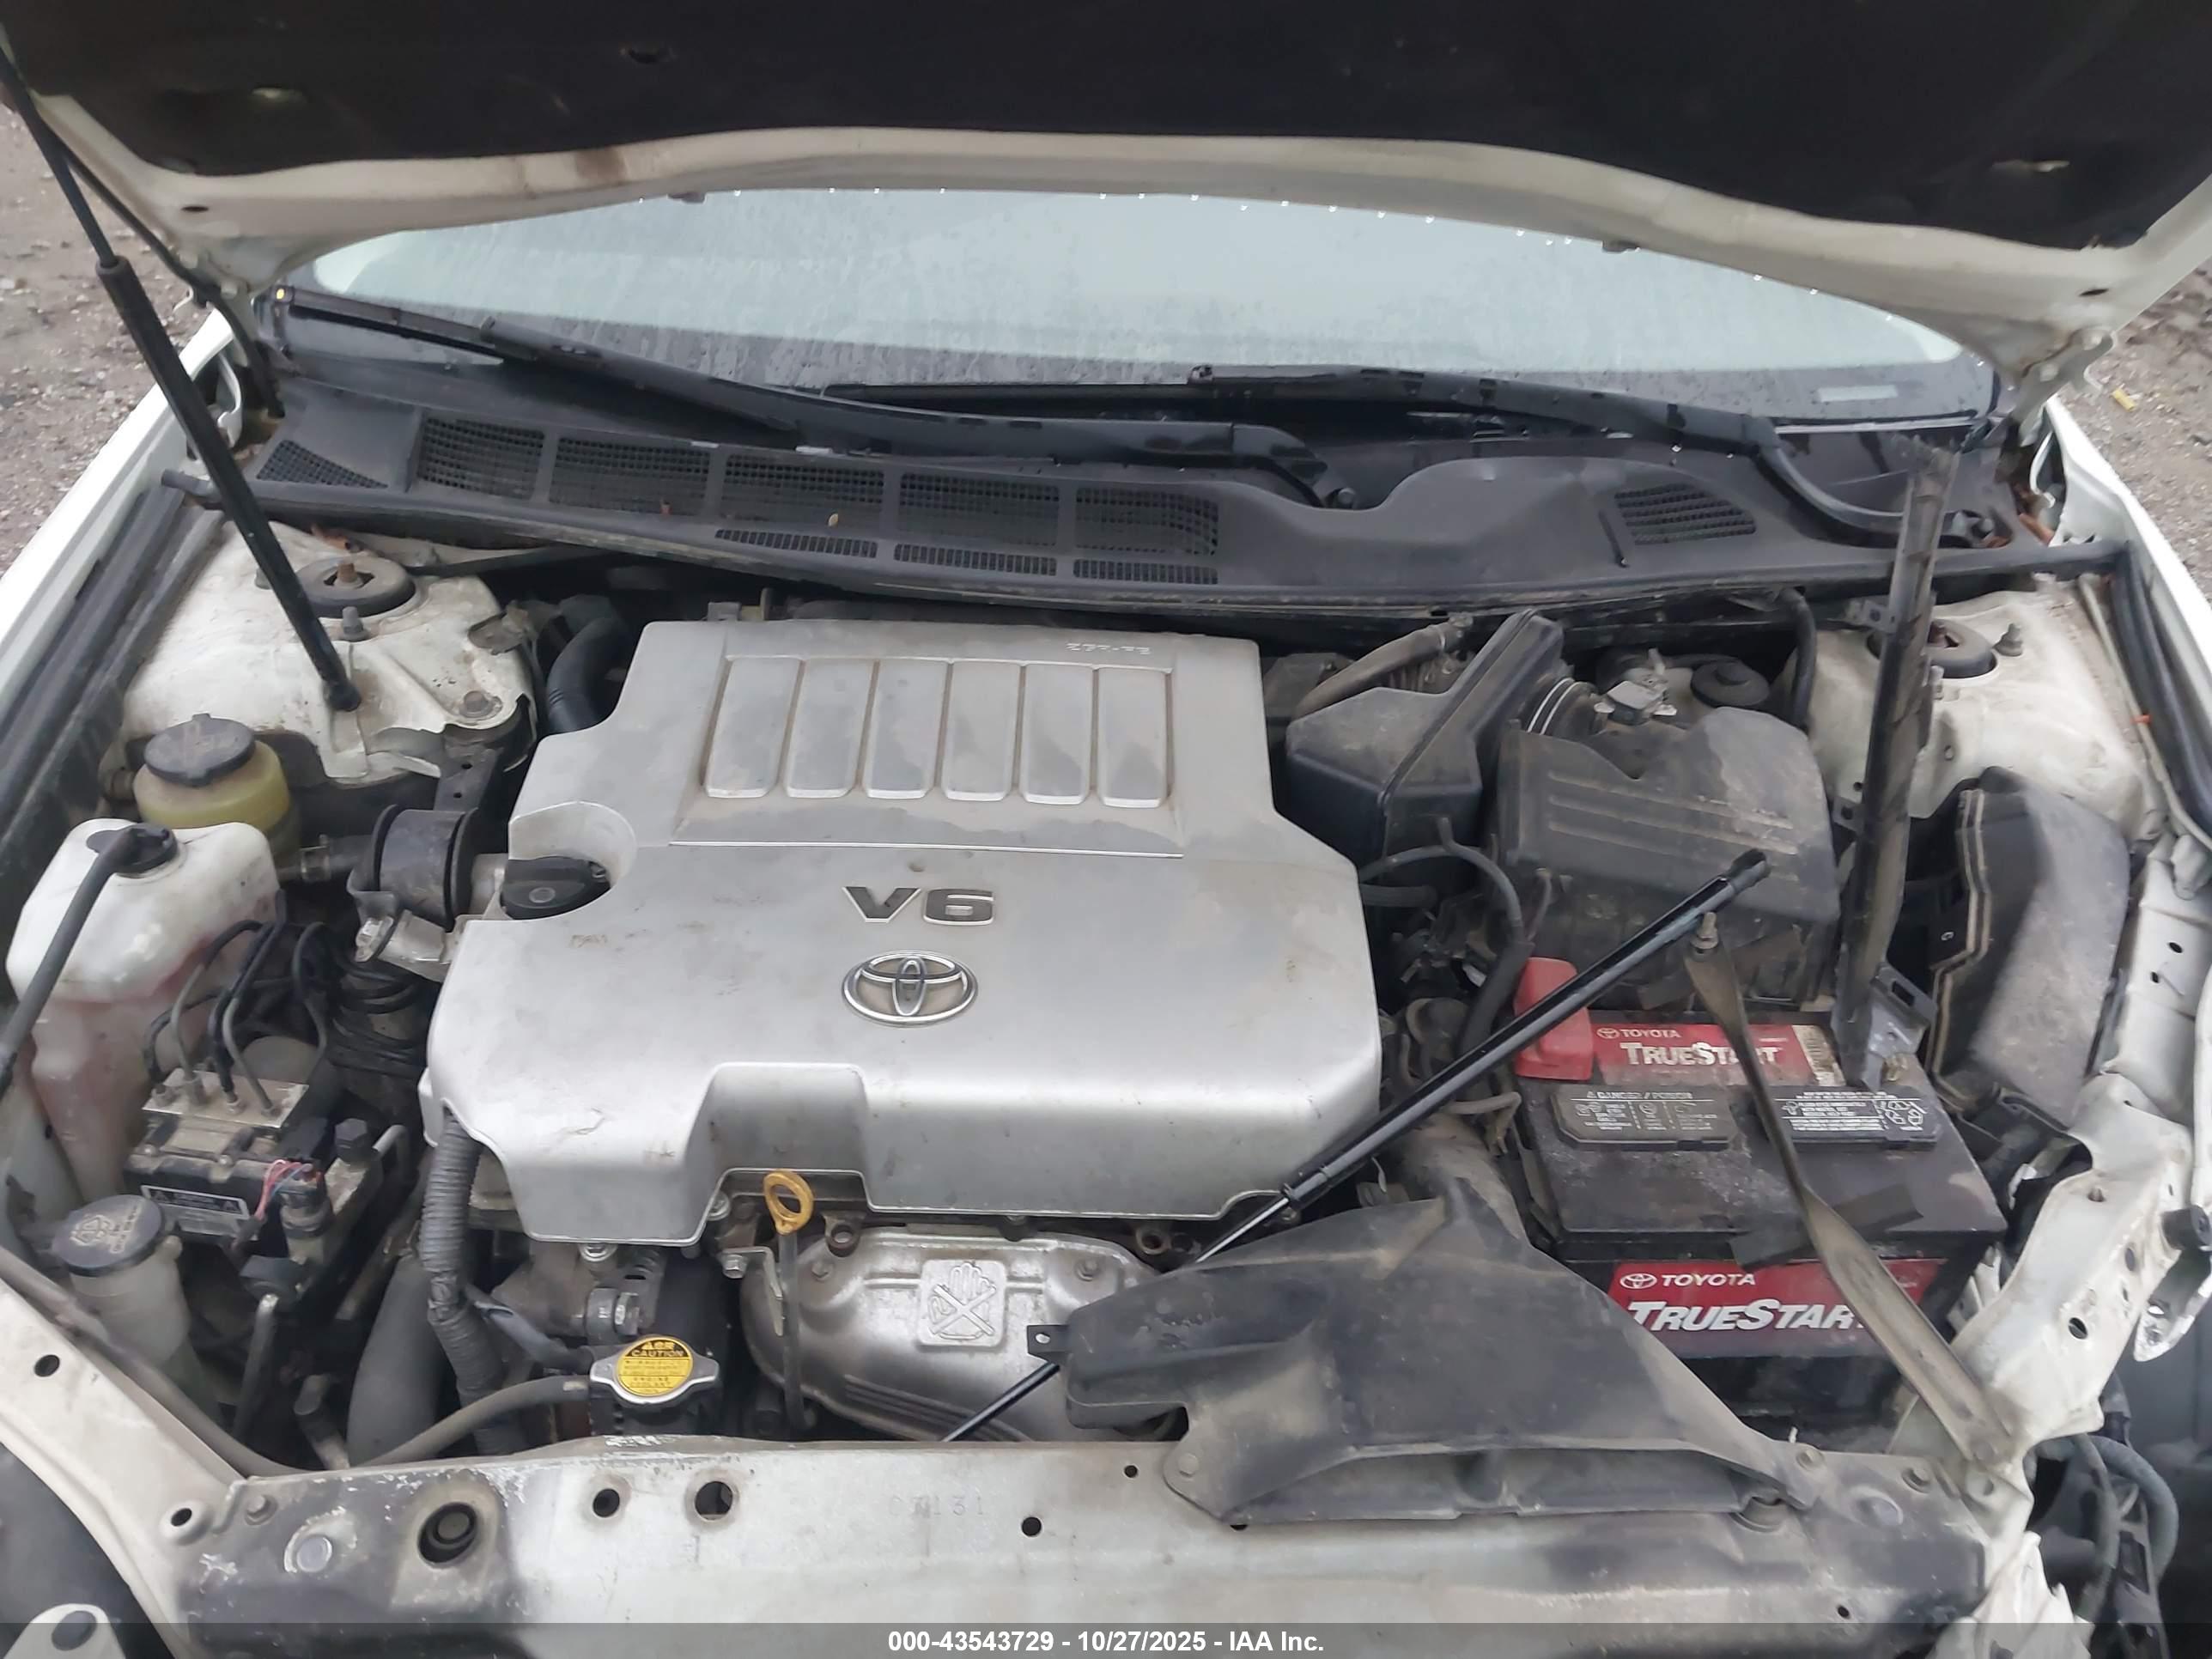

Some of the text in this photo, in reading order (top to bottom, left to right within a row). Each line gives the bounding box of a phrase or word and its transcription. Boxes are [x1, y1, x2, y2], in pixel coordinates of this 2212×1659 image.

[842, 886, 994, 926] V6
[1620, 1029, 1681, 1038] TOYOTA
[1661, 1273, 1756, 1286] TOYOTA
[1627, 1298, 1864, 1331] TRUESTAR
